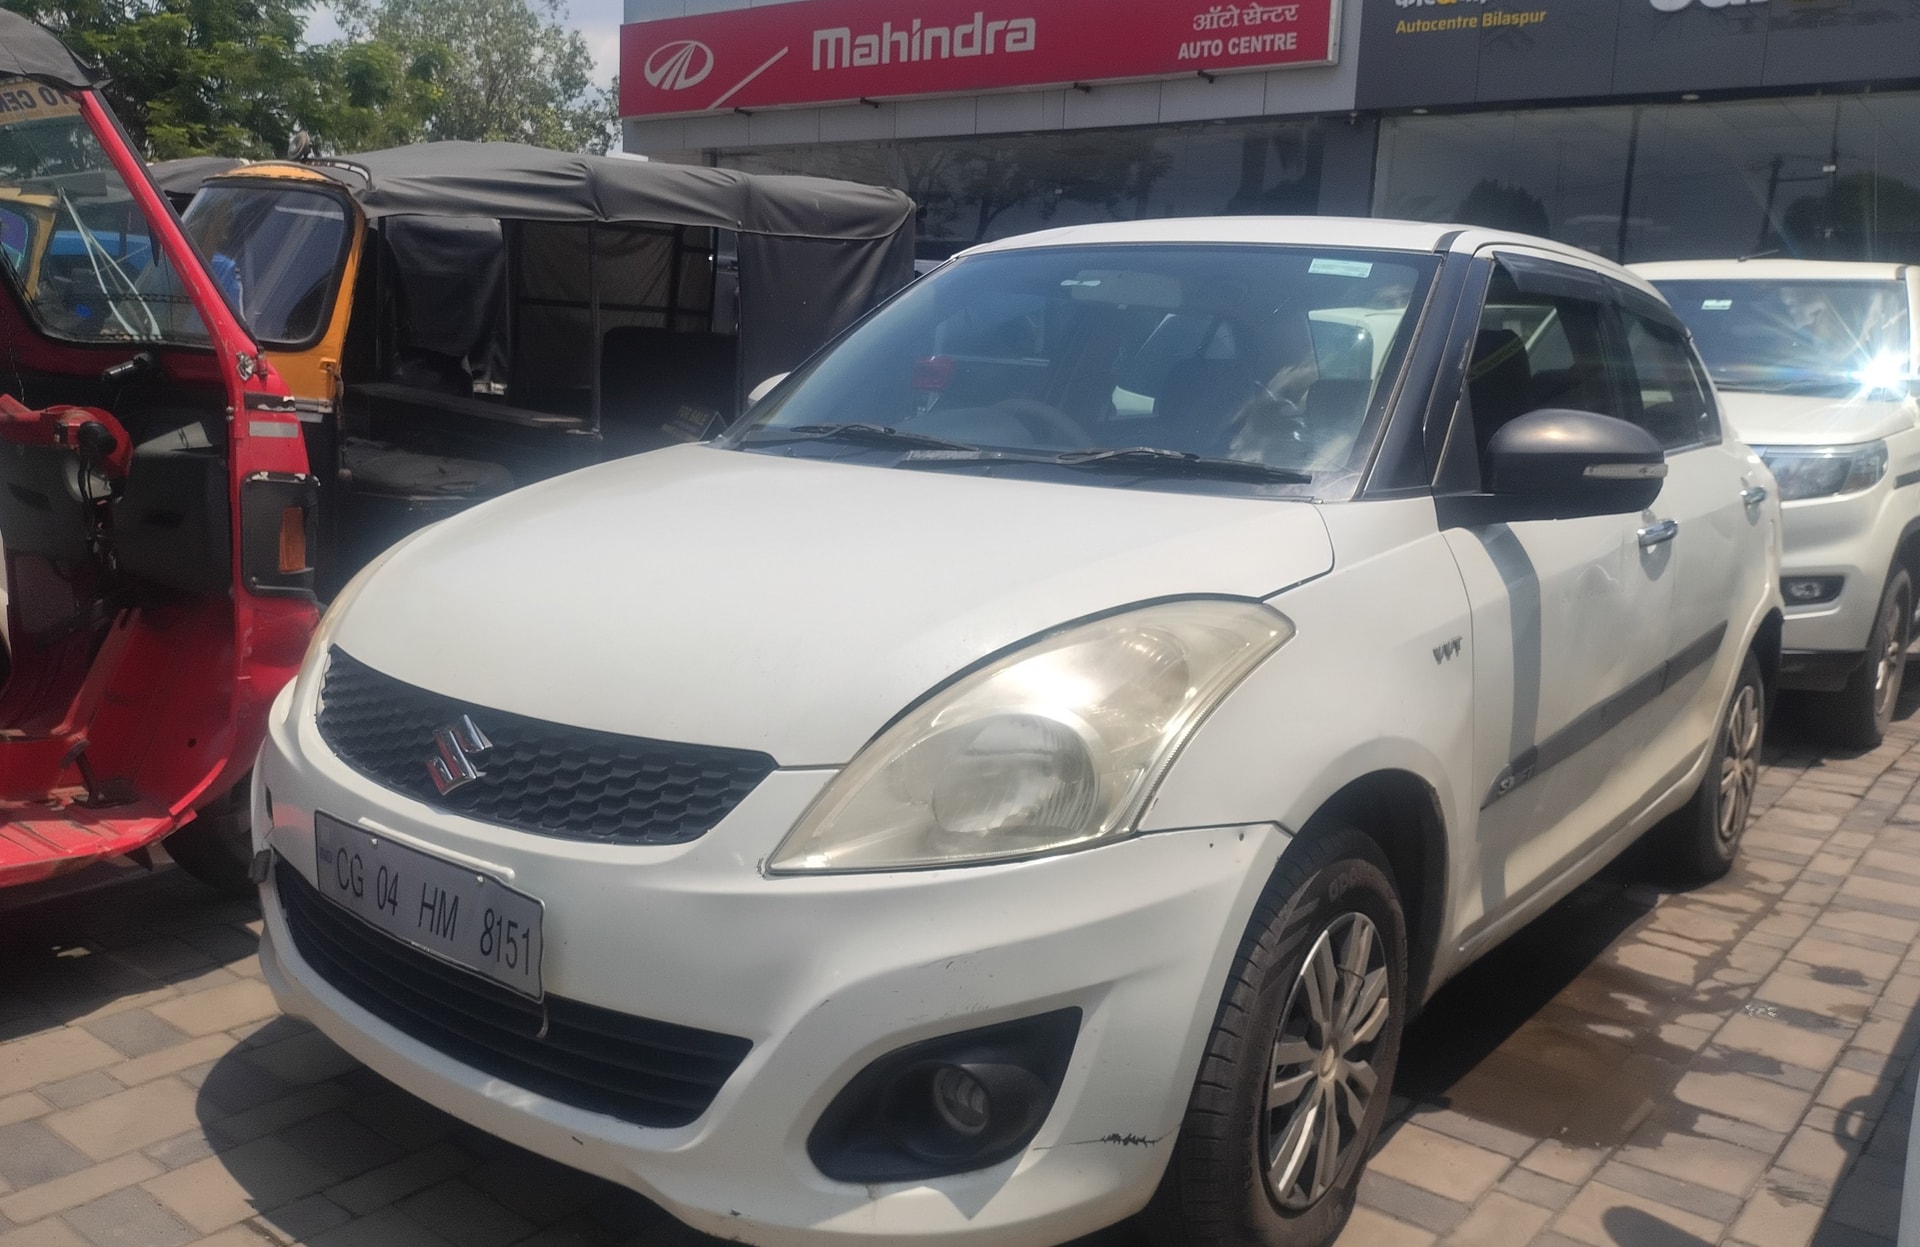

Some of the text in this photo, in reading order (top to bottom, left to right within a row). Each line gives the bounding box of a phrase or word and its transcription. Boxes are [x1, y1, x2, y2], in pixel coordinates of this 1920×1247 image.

[1193, 4, 1240, 31] ऑटो
[1395, 10, 1547, 34] Autocentre Bilaspur
[812, 11, 1036, 71] Mahindra
[1178, 32, 1297, 60] AUTO CENTRE
[1432, 635, 1463, 665] VVT
[337, 847, 531, 976] CG 04 HM 8151
